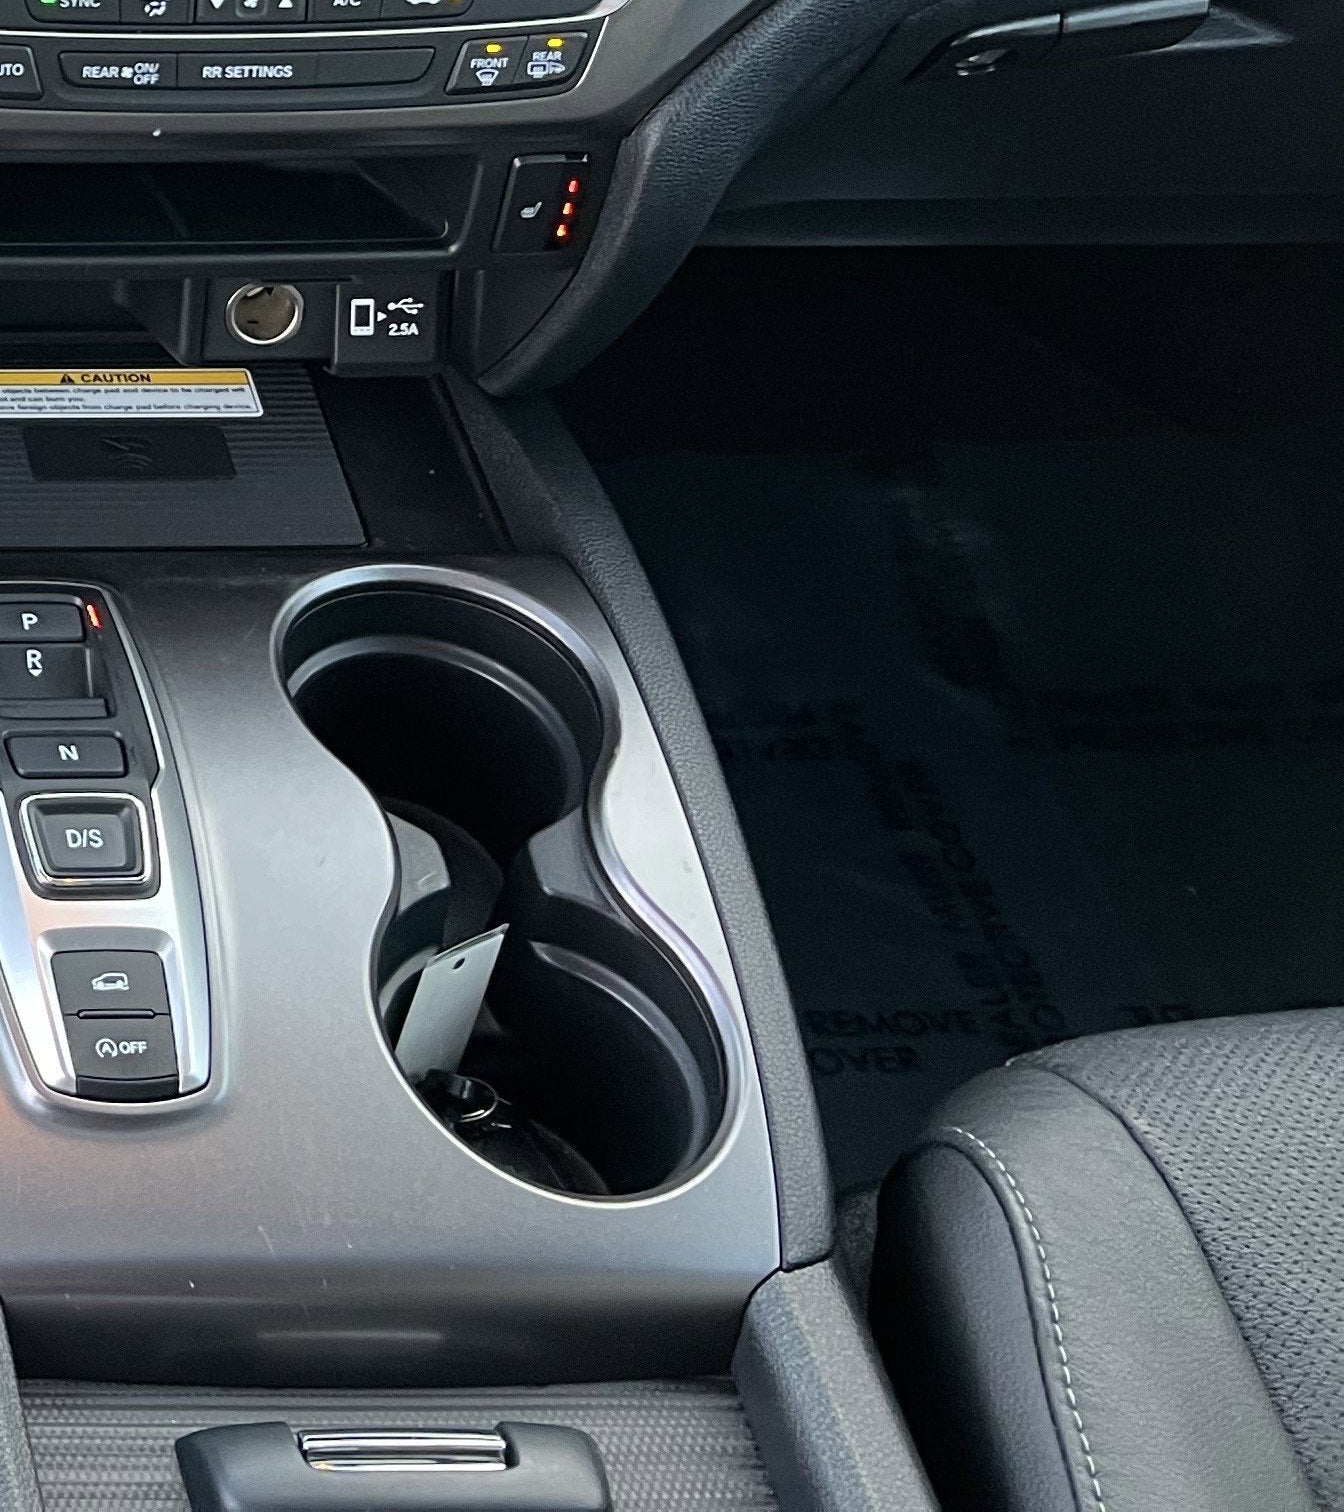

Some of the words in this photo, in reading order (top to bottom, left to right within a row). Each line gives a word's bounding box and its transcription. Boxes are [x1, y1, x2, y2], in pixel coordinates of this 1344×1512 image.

[469, 55, 509, 71] FRONT
[531, 49, 563, 63] REAR
[81, 64, 120, 80] REAR
[133, 72, 161, 86] OFF
[201, 65, 223, 80] RR
[224, 64, 294, 79] SETTINGS
[79, 372, 152, 384] CAUTION
[20, 612, 40, 631] P
[25, 648, 44, 670] R
[57, 743, 81, 763] N
[64, 827, 105, 850] D/S
[118, 1040, 148, 1056] OFF
